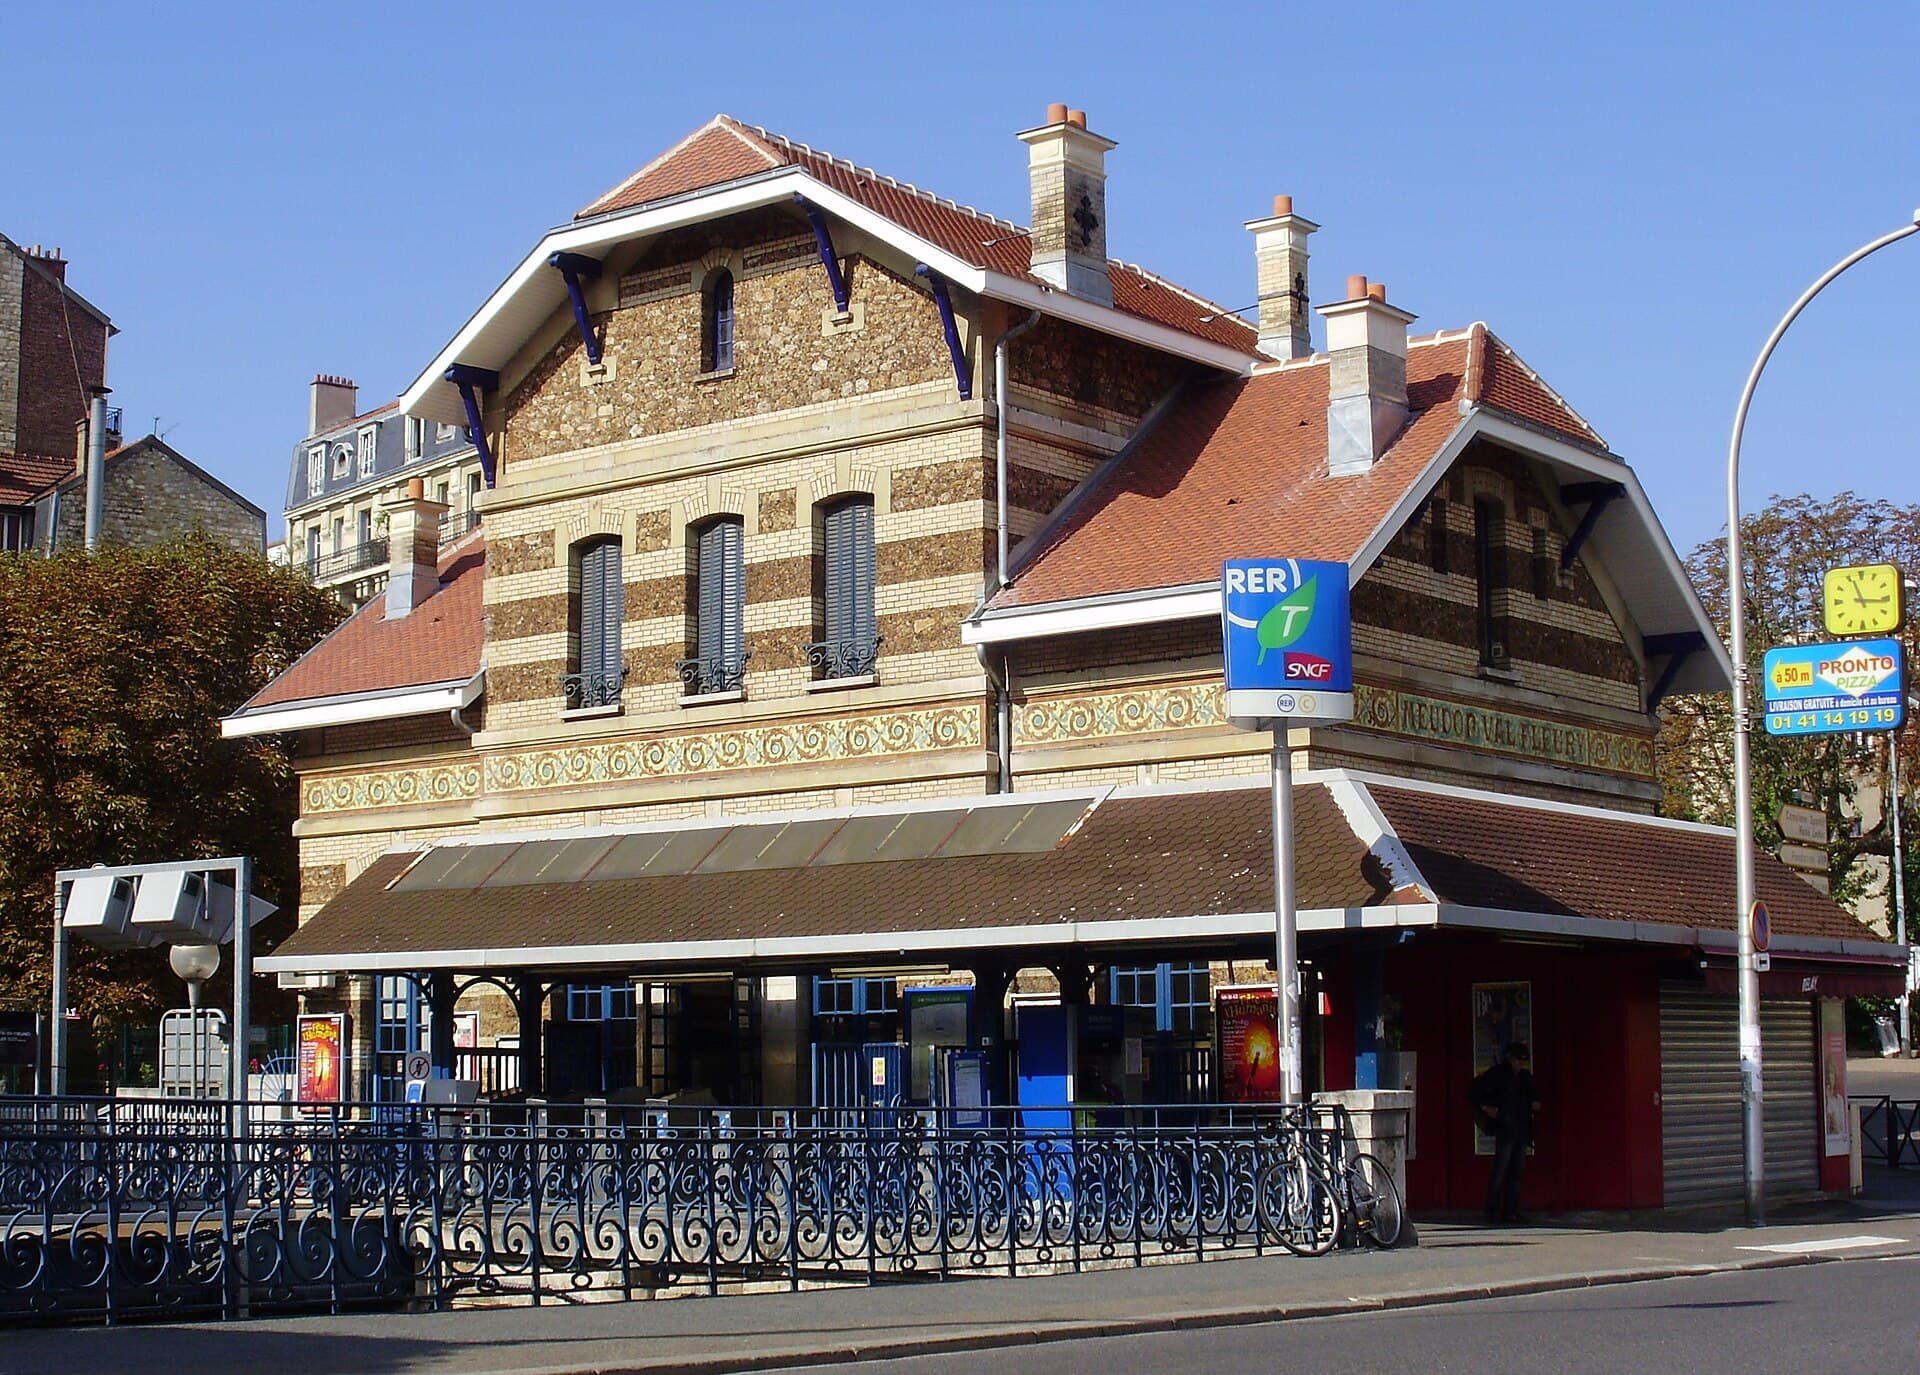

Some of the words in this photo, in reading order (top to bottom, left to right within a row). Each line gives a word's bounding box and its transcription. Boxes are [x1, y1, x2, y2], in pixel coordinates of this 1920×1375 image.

[1227, 567, 1287, 594] RER
[1281, 605, 1309, 638] T
[1286, 662, 1331, 678] SNCF
[1819, 656, 1894, 675] PRONTO
[1776, 672, 1783, 684] à
[1784, 667, 1798, 683] 50
[1800, 671, 1810, 682] m
[1836, 675, 1878, 689] PIZZA
[1279, 699, 1293, 707] RER
[1303, 699, 1310, 709] C
[1769, 700, 1803, 713] LIVRAISON
[1803, 697, 1835, 710] GRATUITE
[1773, 715, 1792, 729] 01
[1798, 714, 1817, 727] 41
[1824, 712, 1844, 725] 14
[1849, 710, 1869, 724] 19
[1875, 708, 1895, 722] 19
[1403, 701, 1476, 739] MEUDON
[1483, 714, 1516, 746] VAL
[1519, 722, 1586, 755] FLEURY
